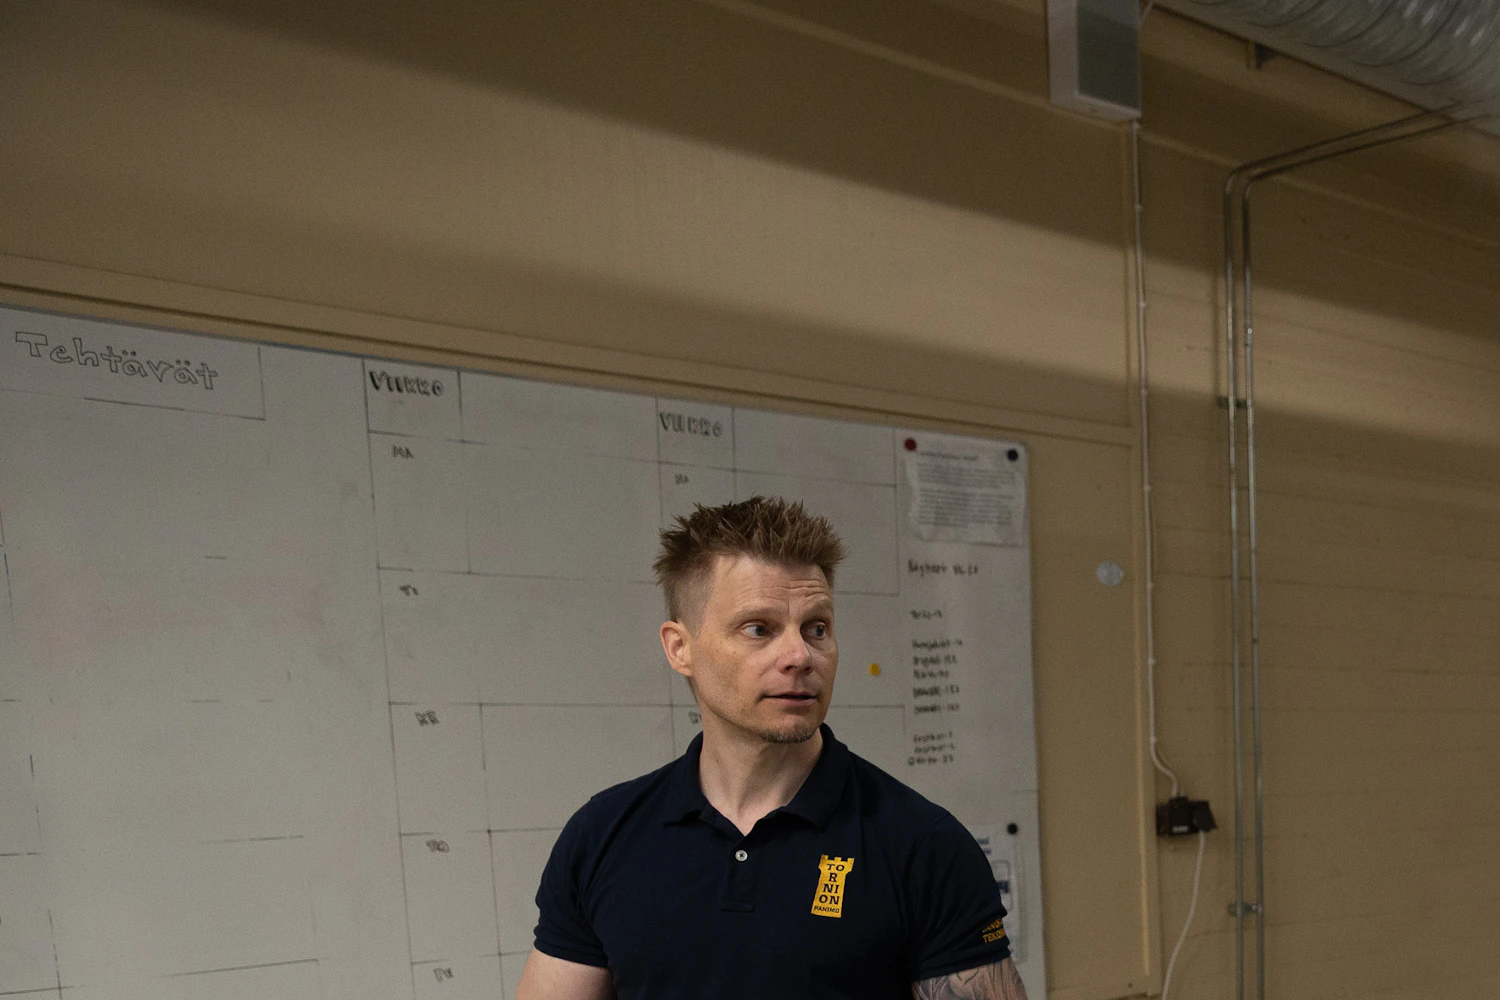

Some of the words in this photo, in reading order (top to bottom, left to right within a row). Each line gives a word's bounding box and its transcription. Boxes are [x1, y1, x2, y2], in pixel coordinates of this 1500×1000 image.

[826, 863, 845, 872] TO
[828, 872, 838, 883] R
[822, 883, 840, 894] NI
[818, 894, 840, 905] ON
